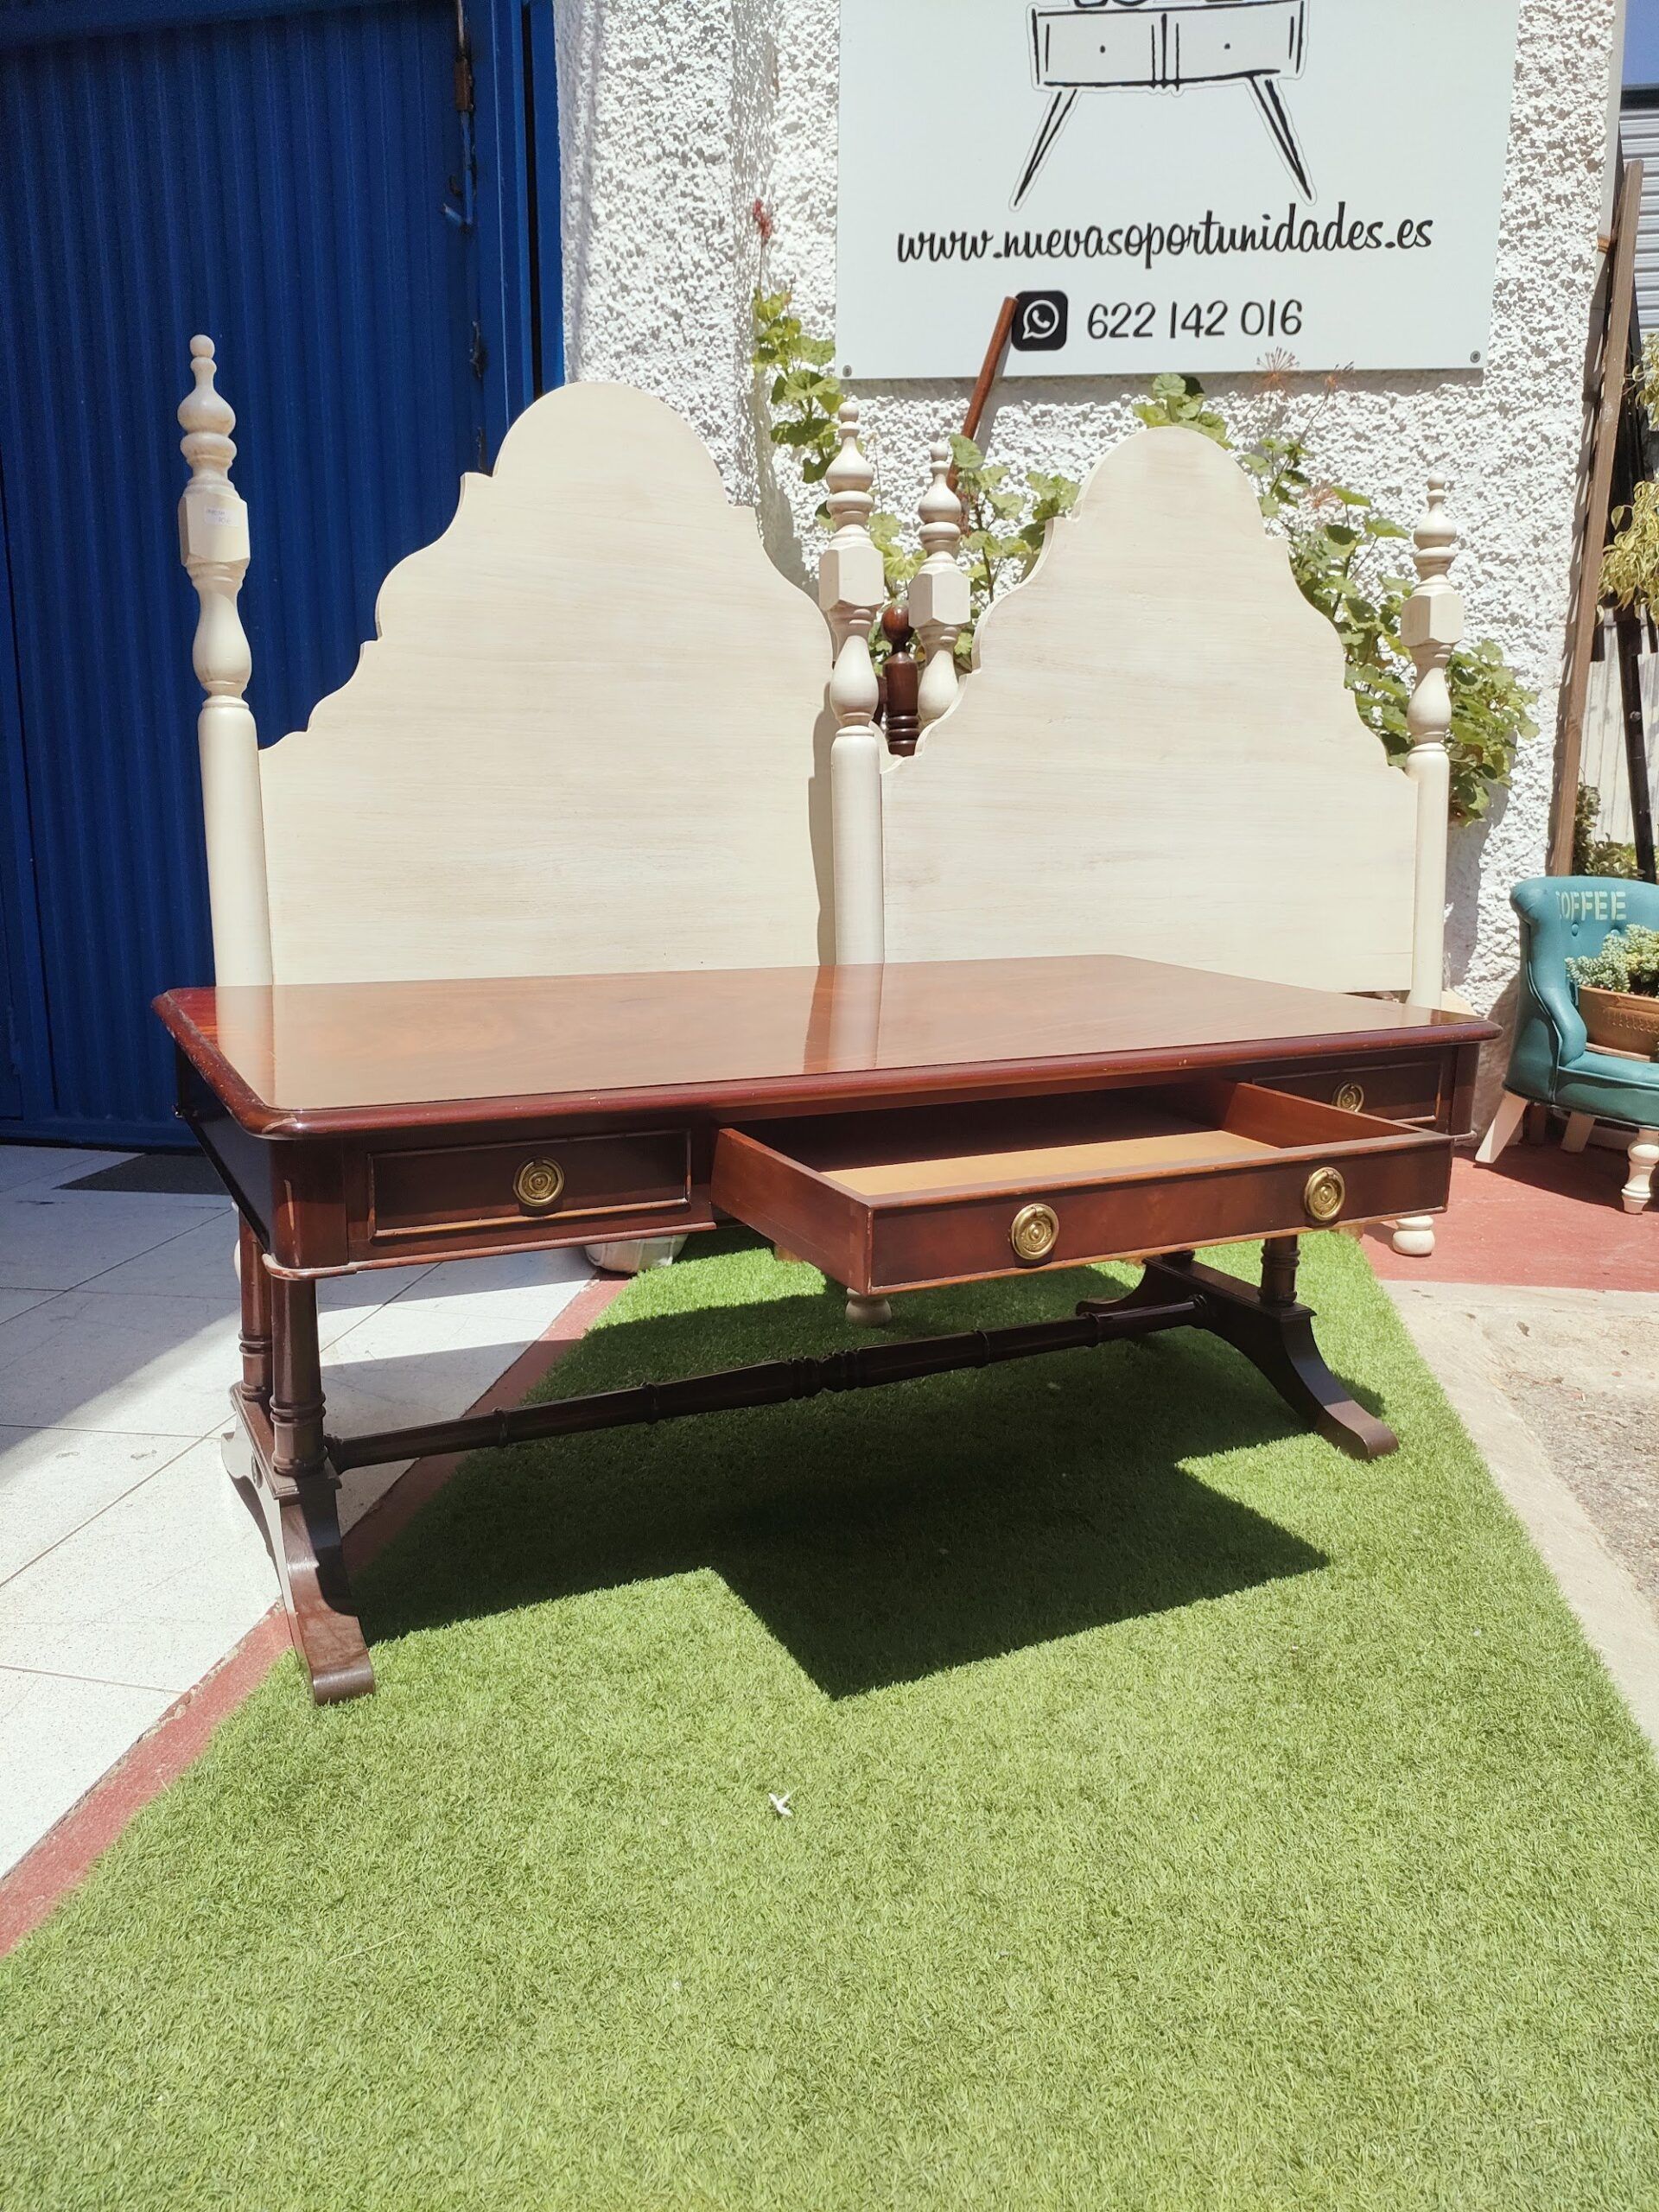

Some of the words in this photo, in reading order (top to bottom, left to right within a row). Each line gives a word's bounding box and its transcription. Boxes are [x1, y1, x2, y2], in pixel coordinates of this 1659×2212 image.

[896, 201, 1434, 270] www.nuevasoportunidades.es
[1086, 302, 1157, 340] 622
[1169, 300, 1230, 339] 142
[1240, 299, 1303, 337] 016
